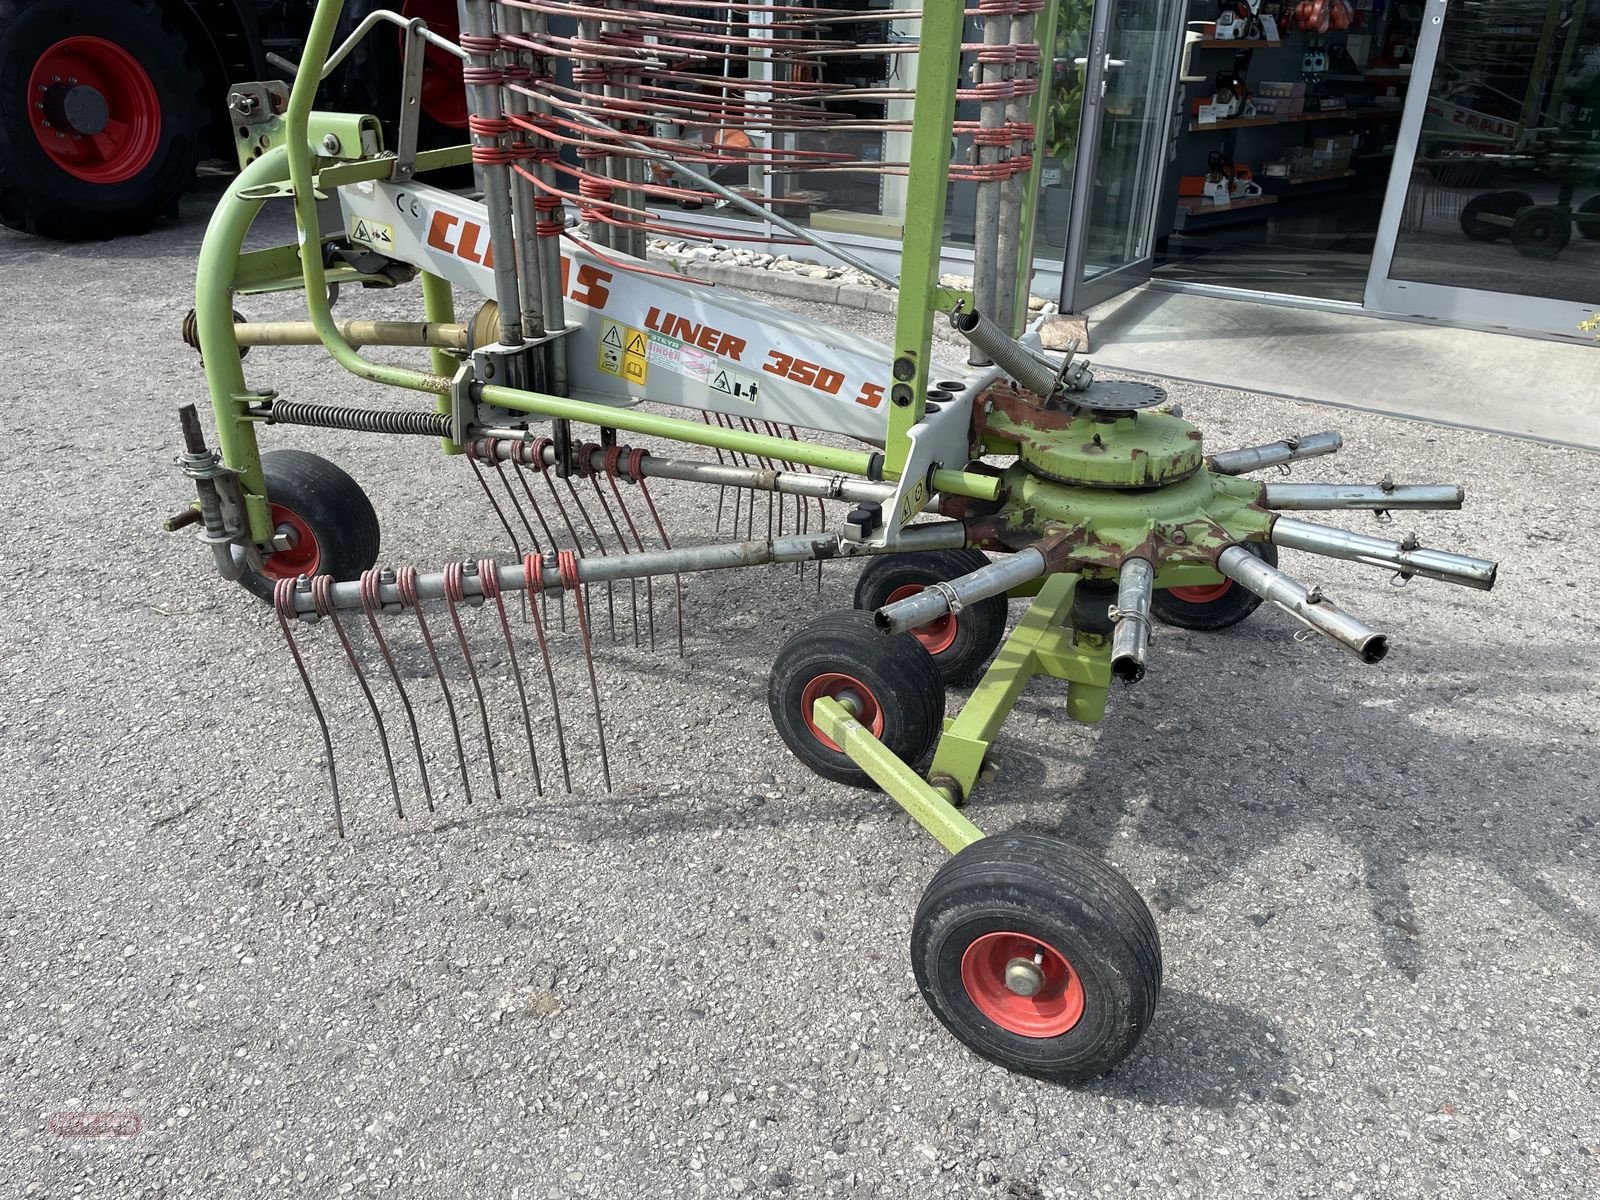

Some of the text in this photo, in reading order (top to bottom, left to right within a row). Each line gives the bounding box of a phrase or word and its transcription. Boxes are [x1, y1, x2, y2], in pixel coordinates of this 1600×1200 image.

[644, 307, 885, 409] LINER 350 S
[650, 334, 680, 349] STEYR
